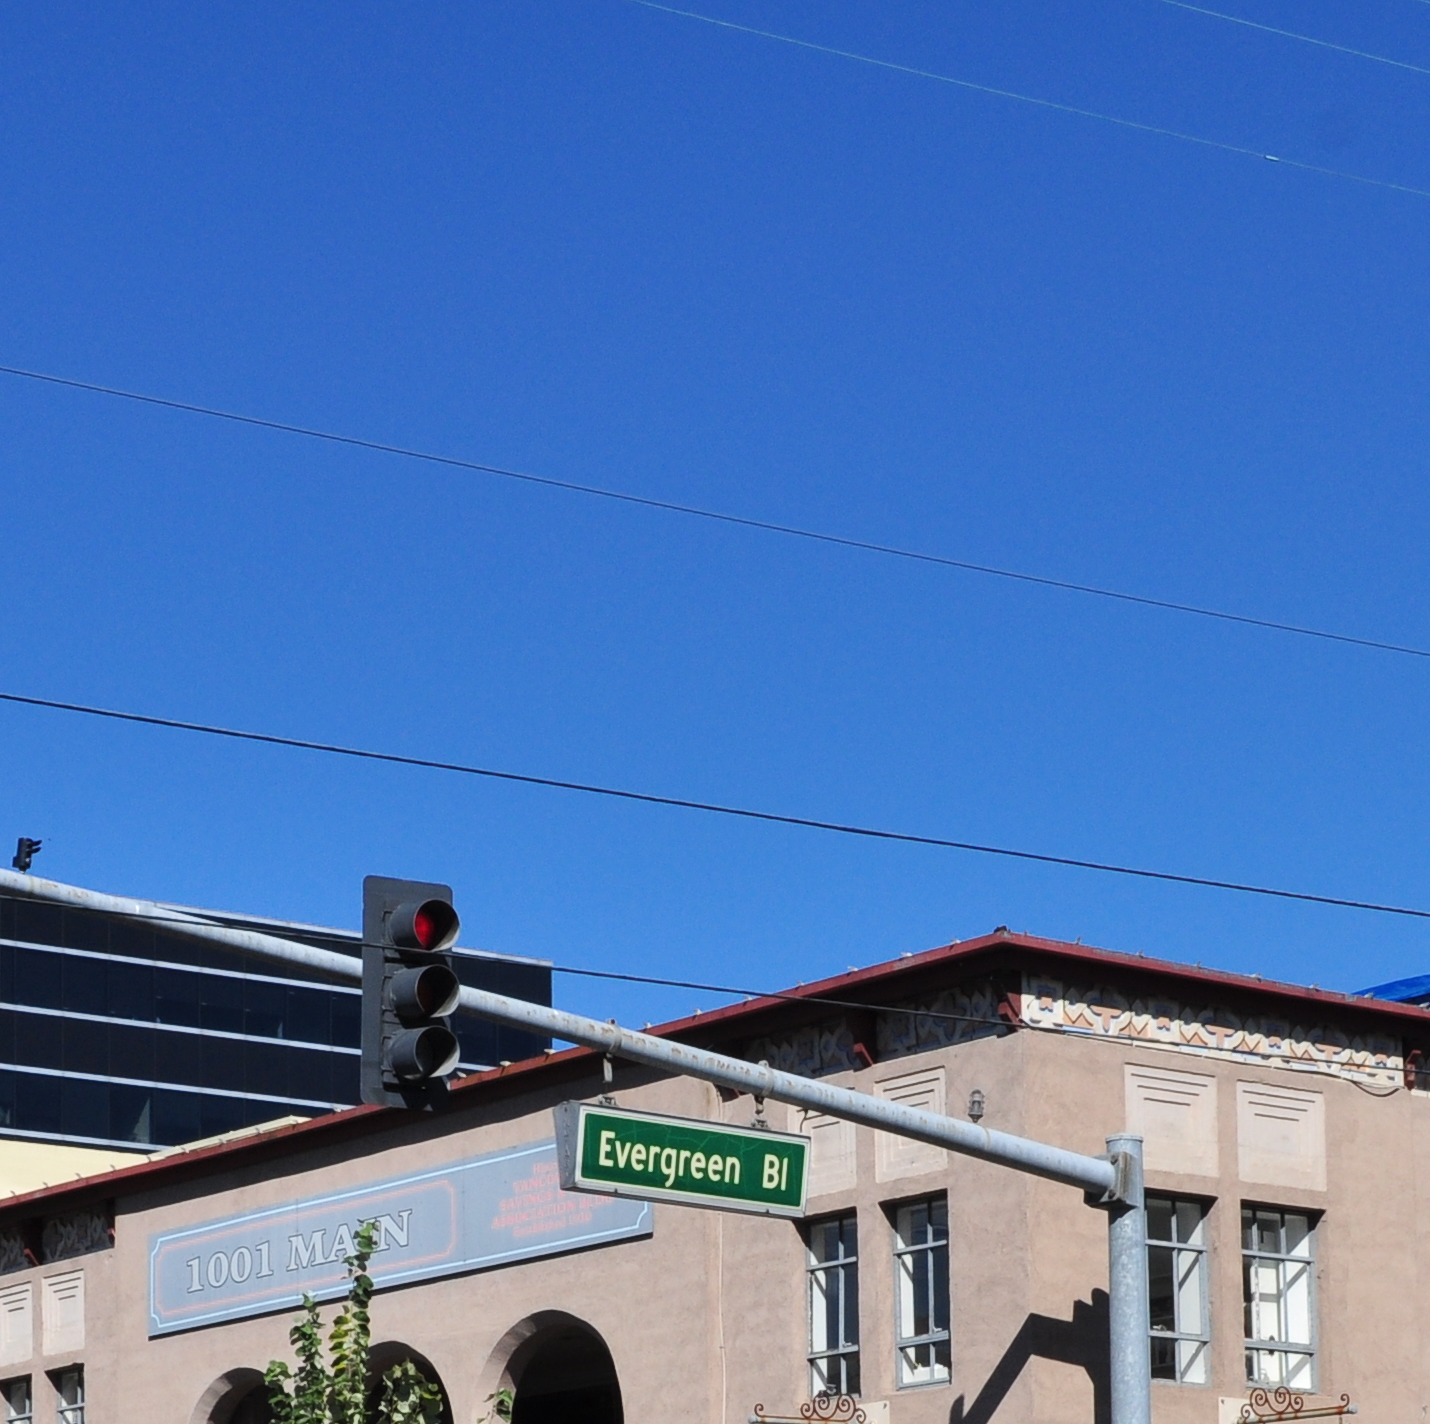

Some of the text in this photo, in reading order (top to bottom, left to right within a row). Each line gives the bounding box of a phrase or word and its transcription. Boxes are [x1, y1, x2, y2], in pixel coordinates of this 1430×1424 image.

[598, 1129, 789, 1191] Evergreen Bl
[186, 1240, 274, 1294] 1001
